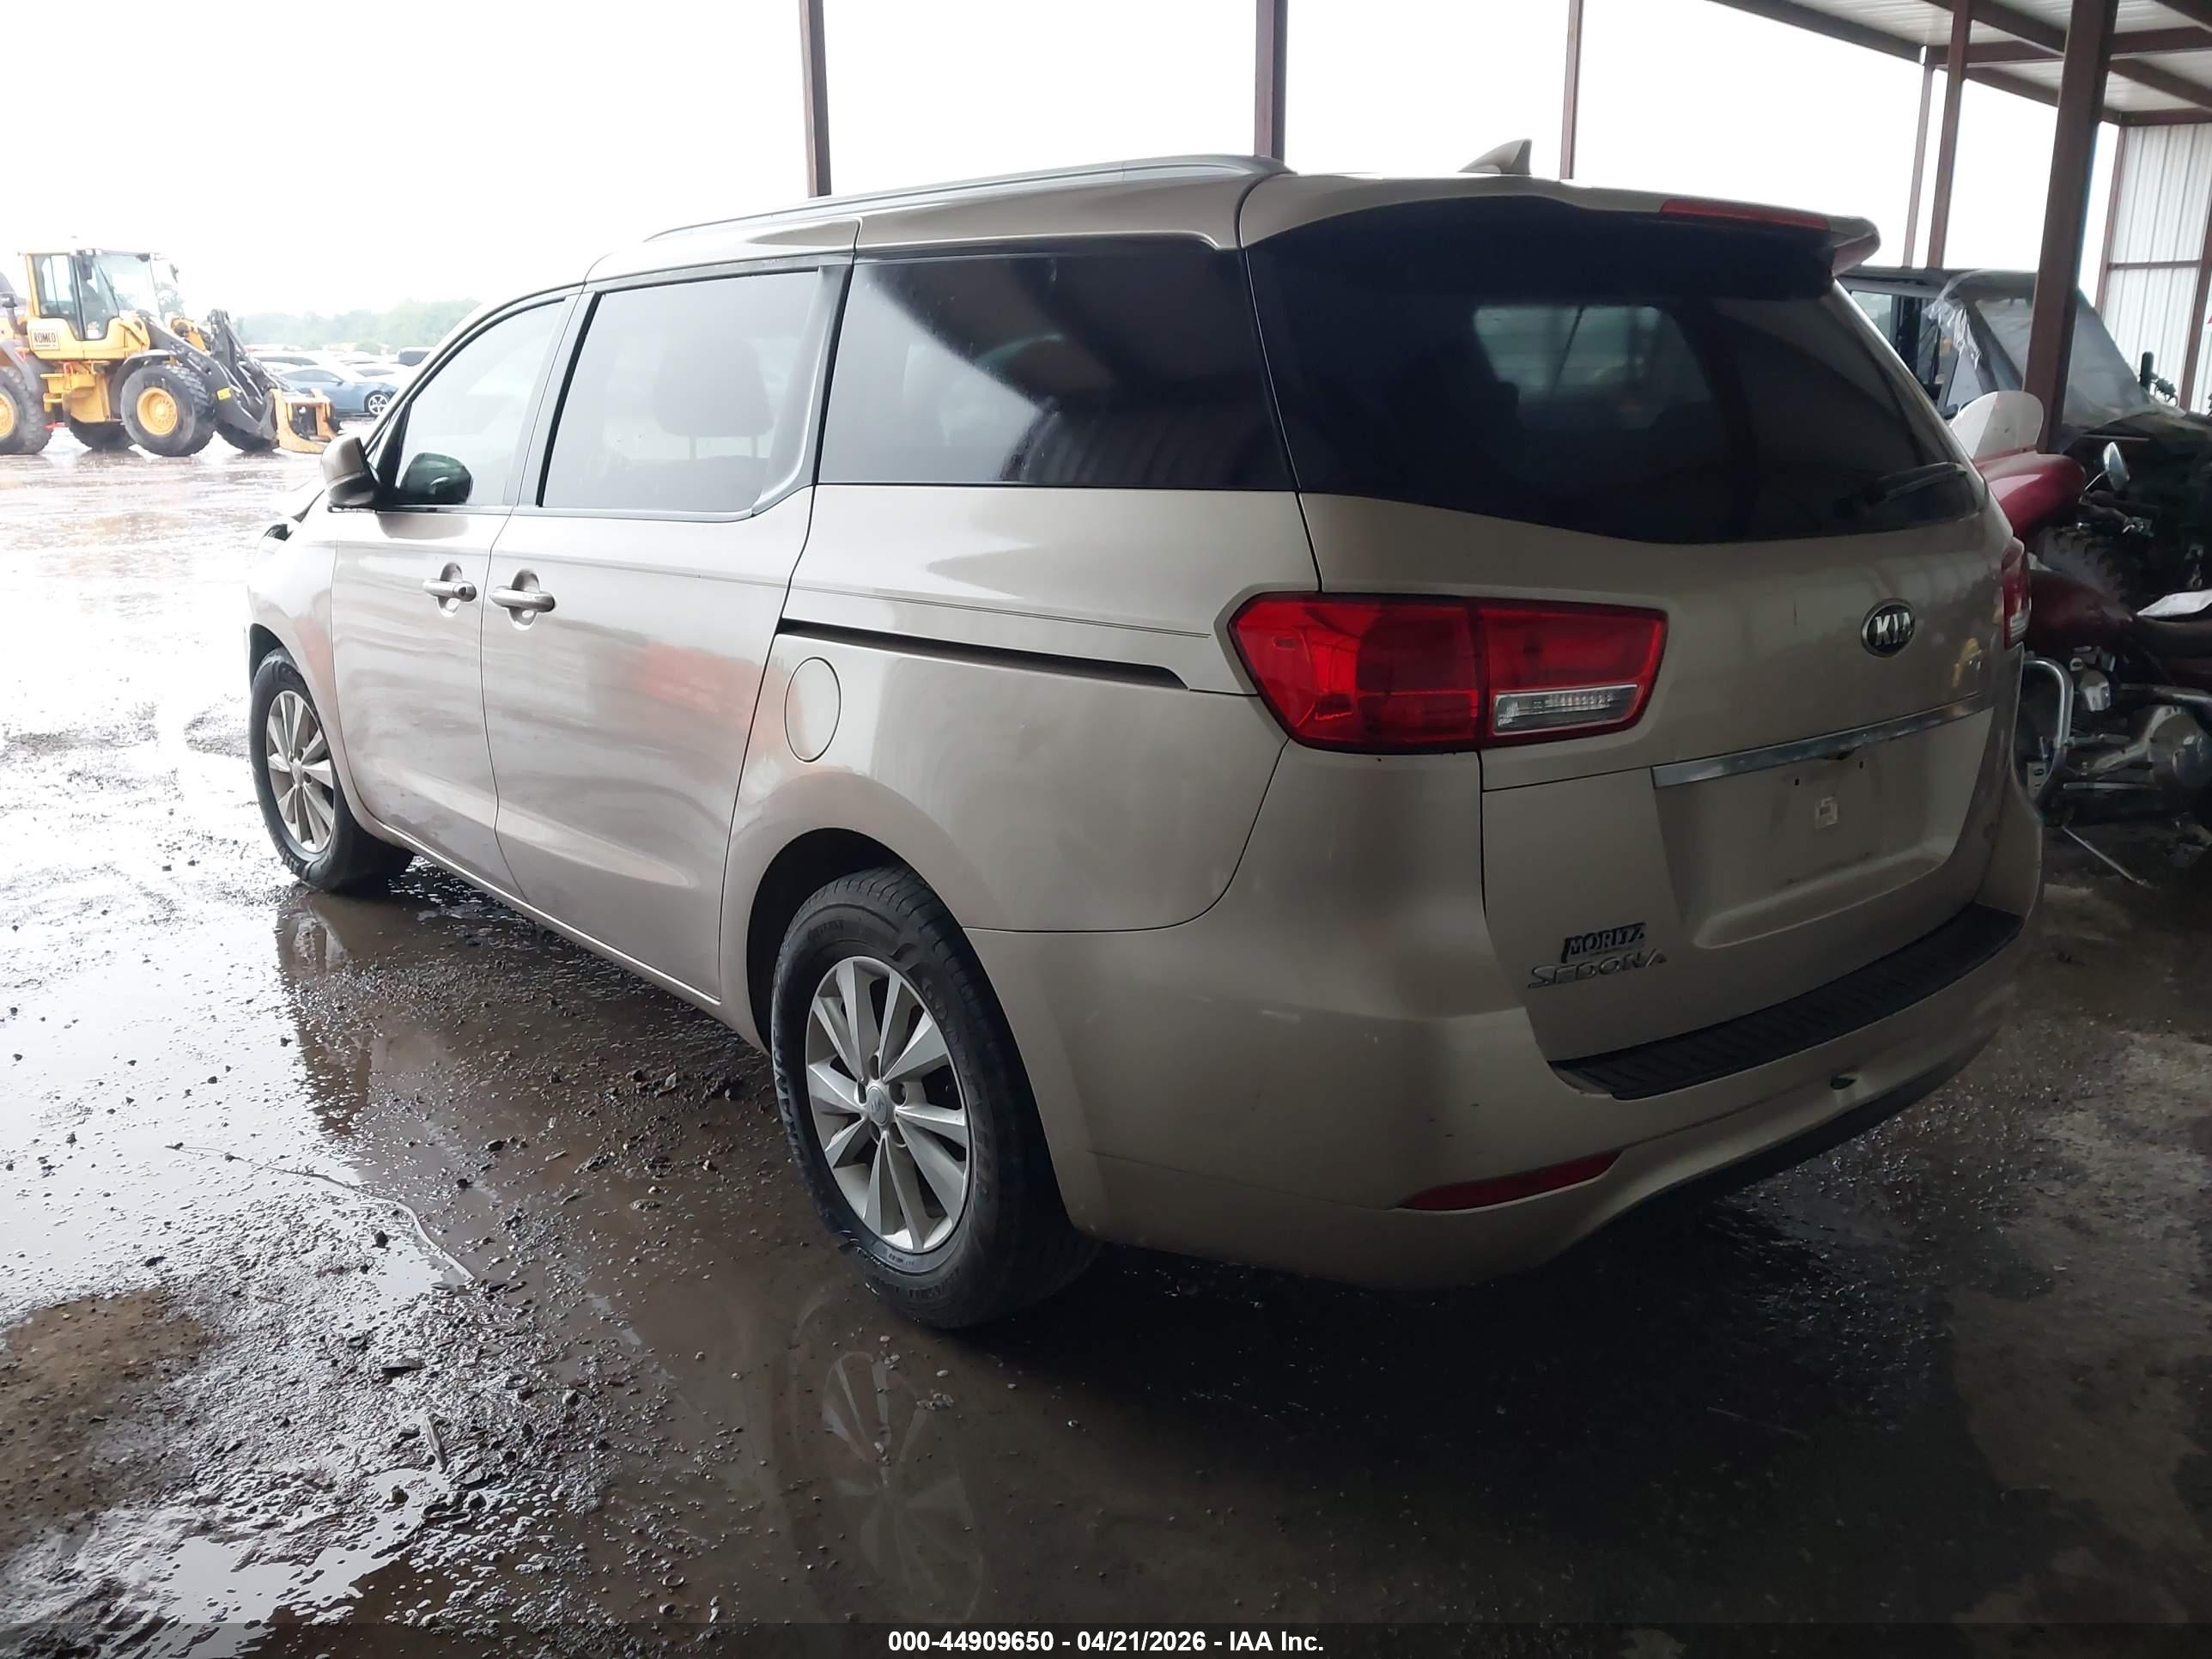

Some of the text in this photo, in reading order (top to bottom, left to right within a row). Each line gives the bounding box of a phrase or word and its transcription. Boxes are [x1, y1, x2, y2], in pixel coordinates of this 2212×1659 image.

[33, 331, 57, 343] ROMCO
[1875, 611, 1914, 646] KIA
[1528, 947, 1668, 989] SEDONA
